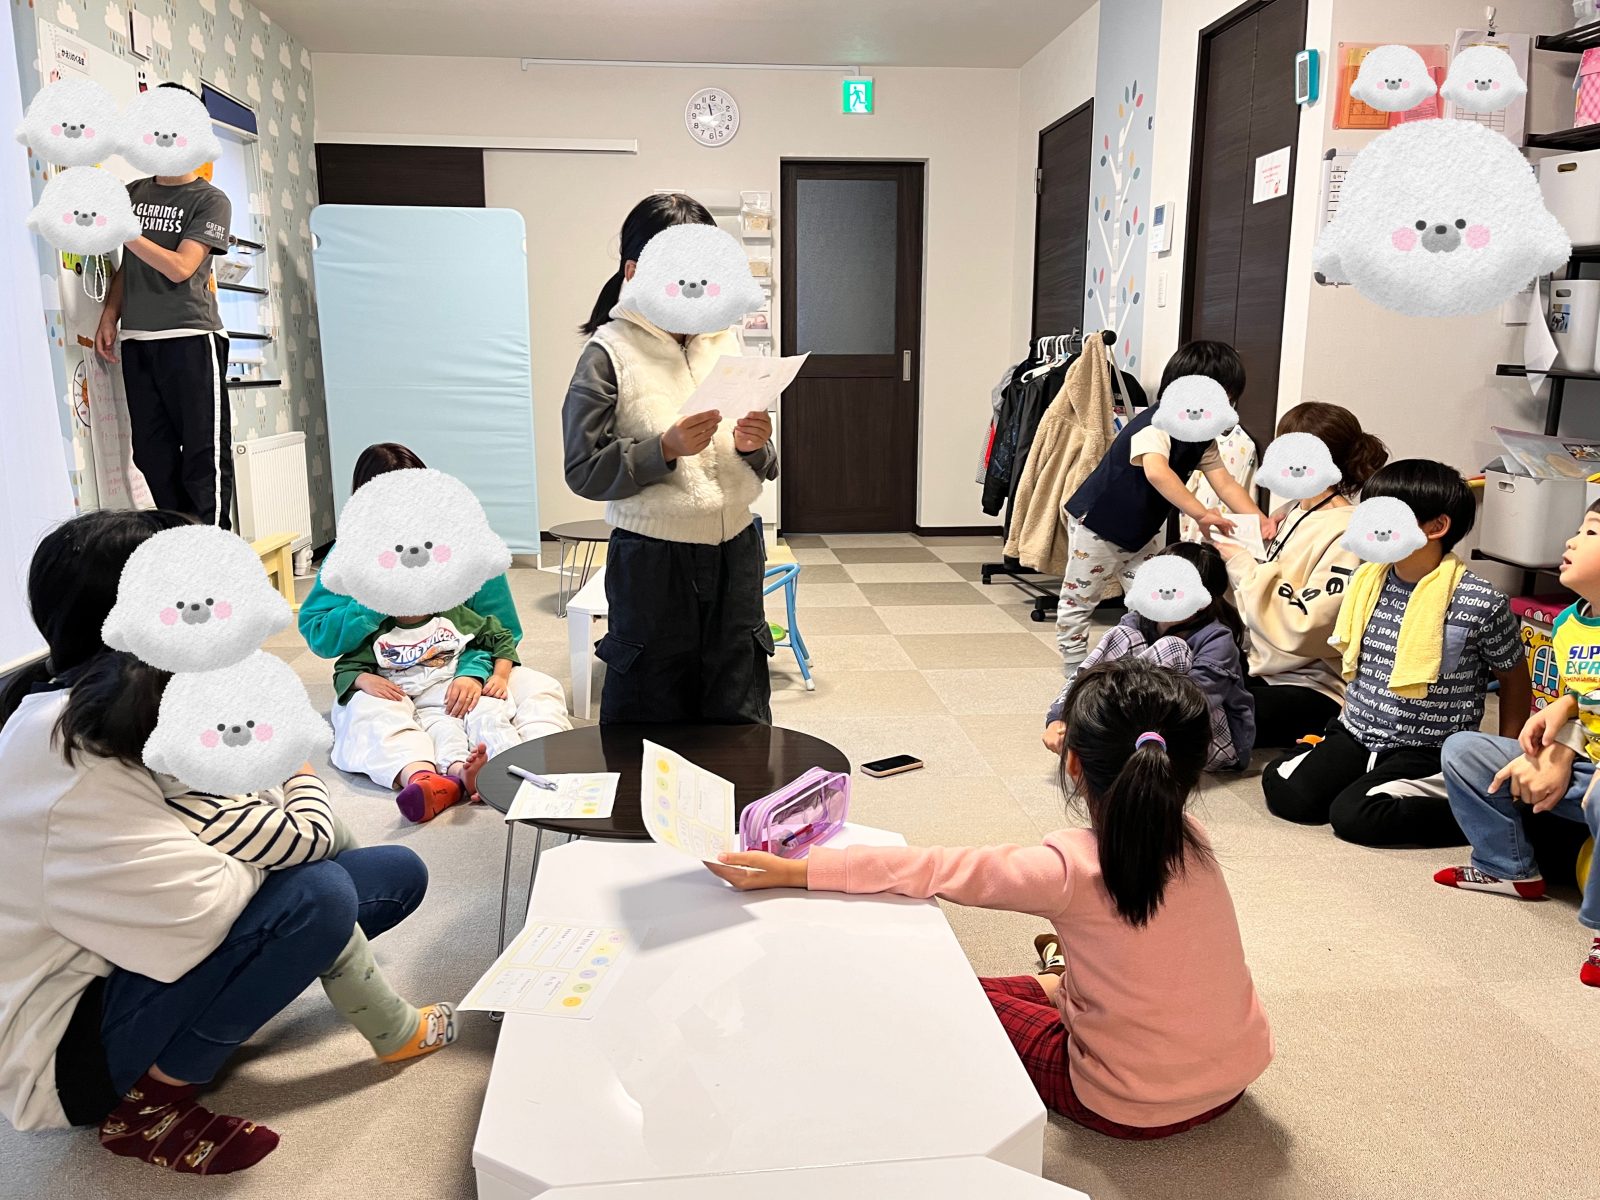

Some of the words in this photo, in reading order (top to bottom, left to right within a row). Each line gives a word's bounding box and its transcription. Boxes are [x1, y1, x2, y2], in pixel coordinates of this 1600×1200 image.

[709, 132, 715, 140] 6
[136, 203, 178, 219] GLARING
[140, 216, 182, 233] ISKNESS
[1378, 702, 1416, 720] Midtown
[1418, 712, 1448, 723] Statue
[1449, 714, 1460, 723] of
